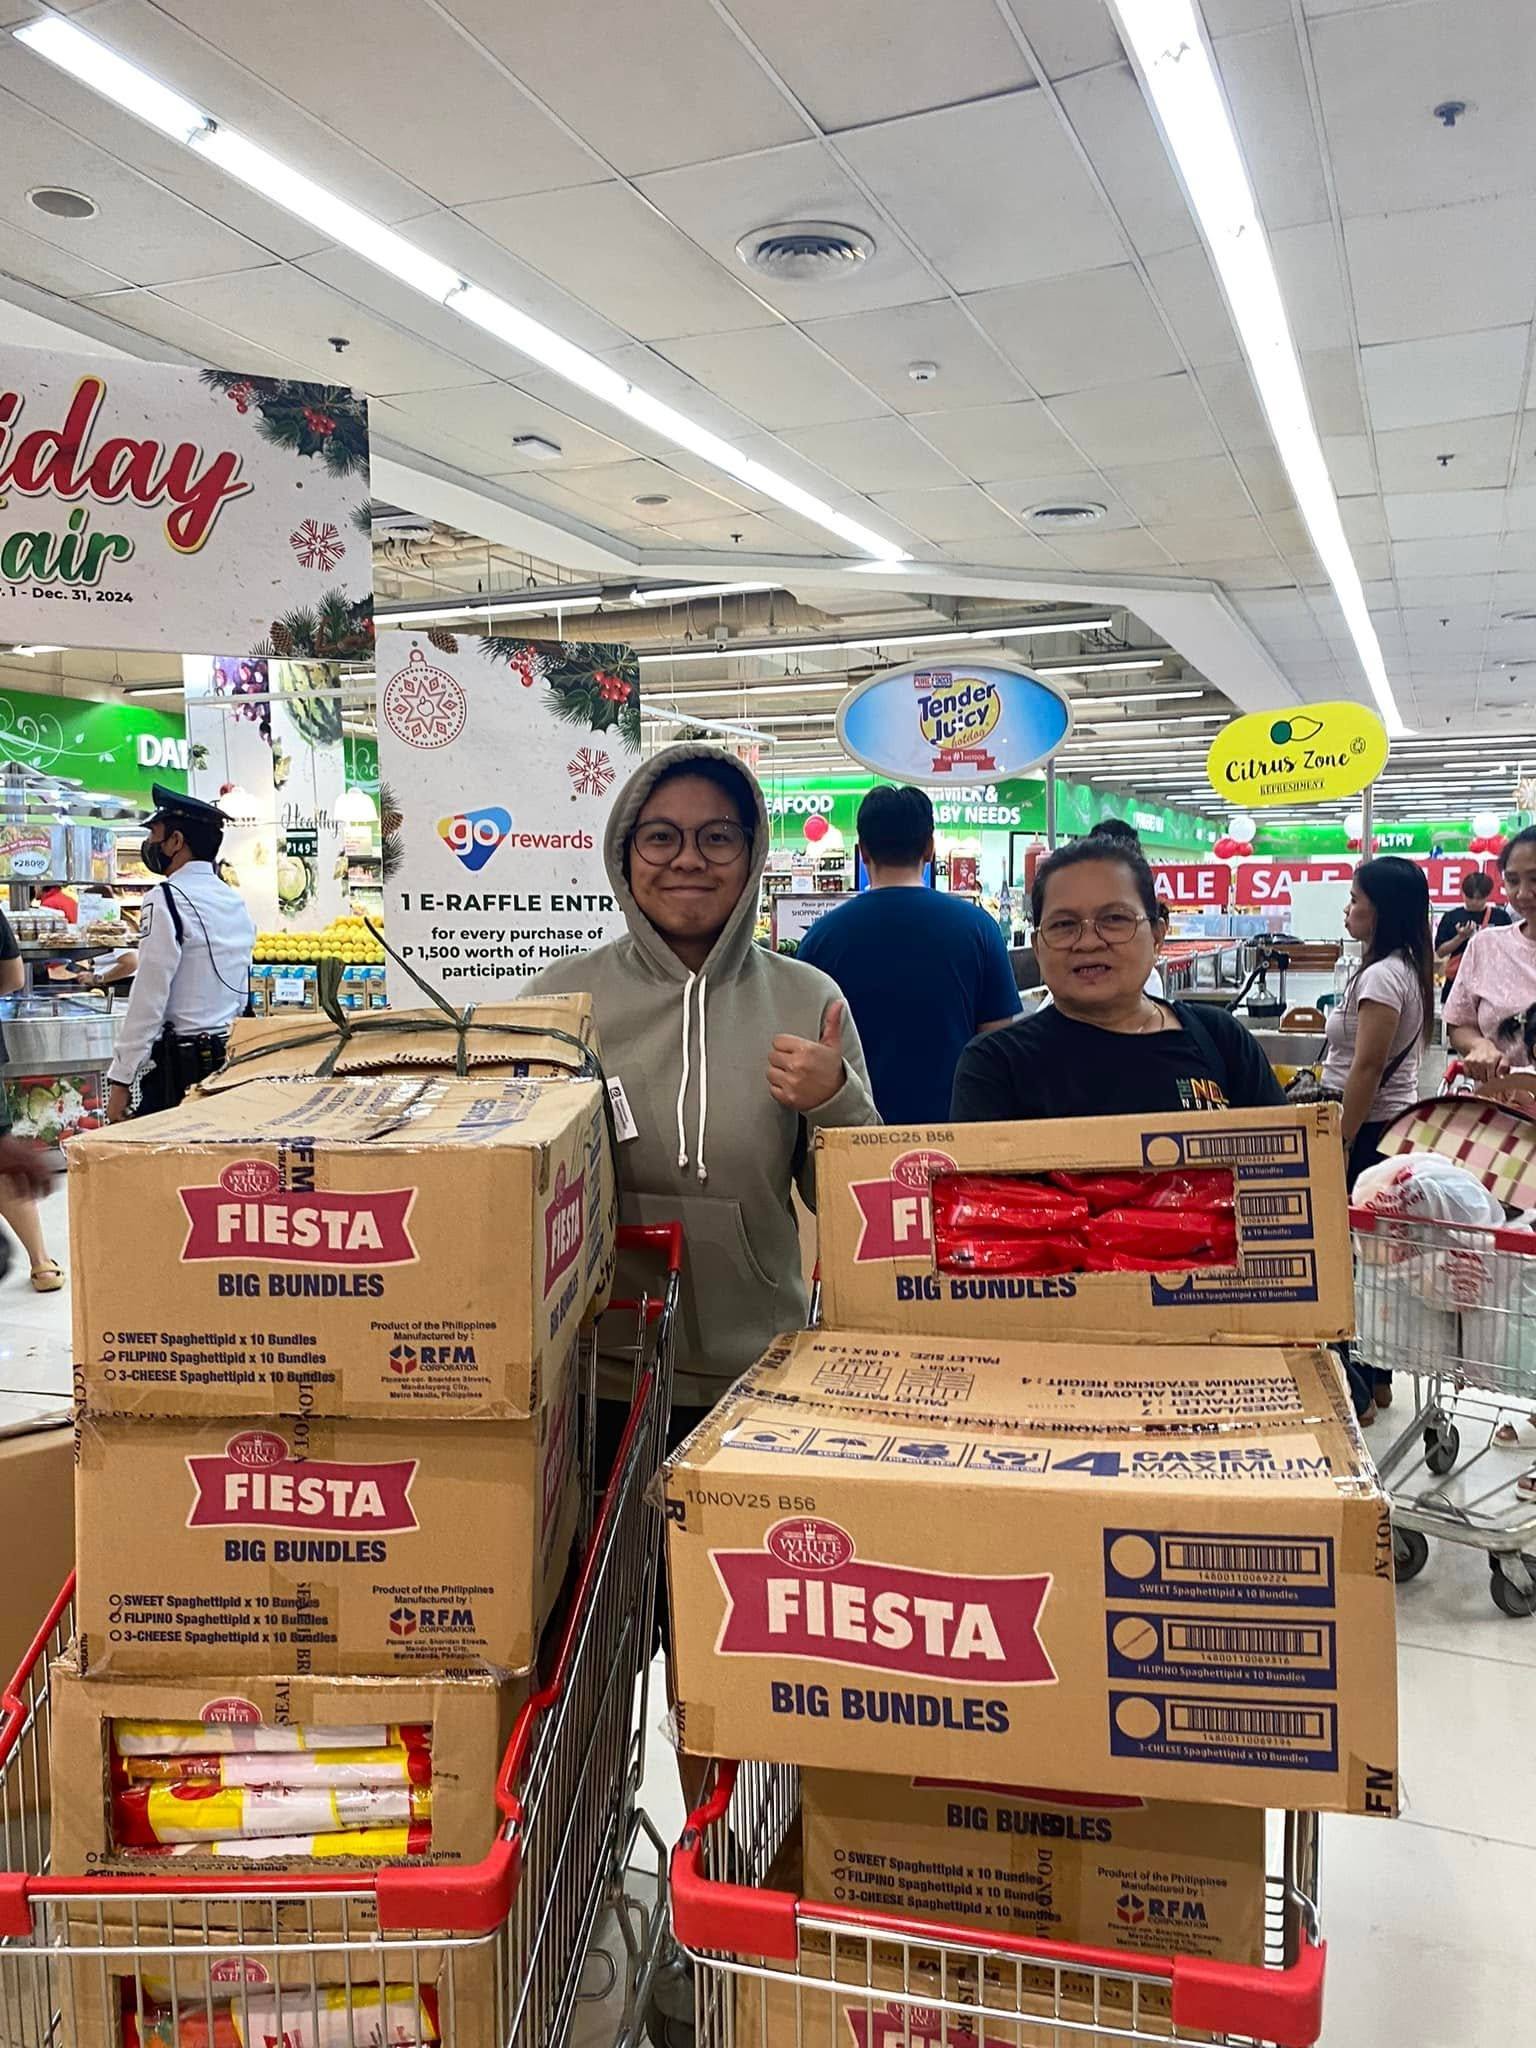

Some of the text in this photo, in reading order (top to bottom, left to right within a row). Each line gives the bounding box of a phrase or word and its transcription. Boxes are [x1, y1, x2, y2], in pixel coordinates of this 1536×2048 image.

[32, 588, 68, 599] Dec.
[72, 590, 92, 602] 31,
[96, 591, 134, 602] 2024
[918, 684, 995, 722] Tender
[930, 704, 989, 745] Juicy
[953, 752, 964, 760] #1
[1226, 750, 1350, 782] Citrus Zone
[985, 785, 998, 802] &
[1260, 778, 1325, 796] REFRESHMENT
[964, 806, 1021, 825] NEEDS
[449, 818, 593, 854] go rewards
[401, 894, 410, 910] 1
[421, 894, 542, 912] E-RAFFLE
[432, 927, 603, 942] for every purchase of
[402, 947, 413, 958] P
[418, 946, 460, 960] 1,500
[465, 946, 513, 958] worth
[519, 946, 534, 958] of
[852, 1131, 921, 1145] 20DEC25
[228, 1174, 273, 1184] WHITE
[234, 1183, 267, 1192] KING
[217, 1203, 384, 1250] FIESTA
[552, 1198, 580, 1271] FIESTA
[218, 1274, 384, 1297] BIG BUNDLES
[897, 1275, 1077, 1300] BIG BUNDLES
[371, 1321, 496, 1332] Product of the Philippines
[118, 1332, 316, 1346] SWEET Spaghettipid x 10 Bundles
[394, 1332, 468, 1342] Manufactured by
[118, 1352, 326, 1366] FILIPINO Spaghettipid x 10 Bundles
[420, 1346, 476, 1364] RFM
[420, 1364, 478, 1372] CORPORATION
[119, 1370, 336, 1384] 3-CHEESE Spaghettipid x 10 Bundles
[1047, 1378, 1108, 1388] HEIGHT
[1114, 1378, 1200, 1388] STACKING
[1205, 1376, 1298, 1388] MAXIMUM
[824, 1388, 948, 1407] PALLET PATTERN
[1082, 1389, 1166, 1398] ALLOWED
[1171, 1388, 1228, 1397] LAYER
[1232, 1386, 1300, 1396] PALLET
[1176, 1404, 1304, 1416] CASES/LAYER
[241, 1454, 274, 1463] KING
[1132, 1448, 1272, 1462] CASES
[1052, 1452, 1128, 1477] 4
[1132, 1456, 1332, 1473] MAXIMUM
[1131, 1470, 1331, 1480] STACKING HEIGHT
[224, 1474, 386, 1518] FIESTA
[685, 1490, 816, 1511] 10NOV25 B56
[225, 1540, 386, 1562] BIG BUNDLES
[780, 1538, 842, 1554] WHITE
[788, 1550, 835, 1565] KING
[372, 1586, 494, 1595] Product of the Philippines
[1140, 1584, 1299, 1600] SWEET Spaghettipid x 10 Bundles
[124, 1595, 320, 1608] SWEET Spaghettipid x 10 Bundles
[394, 1596, 467, 1606] Manufactured by
[420, 1609, 474, 1626] RFM
[767, 1578, 1006, 1662] FIESTA
[1138, 1664, 1178, 1675] FILIPINO
[1180, 1666, 1242, 1680] Spaghettipid
[1253, 1670, 1264, 1680] 10
[1266, 1671, 1306, 1682] Bundles
[771, 1681, 1010, 1734] BIG BUNDLES
[1140, 1743, 1181, 1755] 3-CHEESE
[1184, 1746, 1246, 1760] Spaghettipid
[1257, 1750, 1268, 1760] 10
[1270, 1752, 1310, 1764] Bundles
[947, 1803, 1112, 1842] BIG BUNDLES
[848, 1851, 1043, 1886] SWEET Spaghettipid x 10 Bundles
[1149, 1898, 1206, 1921] RFM
[1148, 1917, 1209, 1929] CORPORATION
